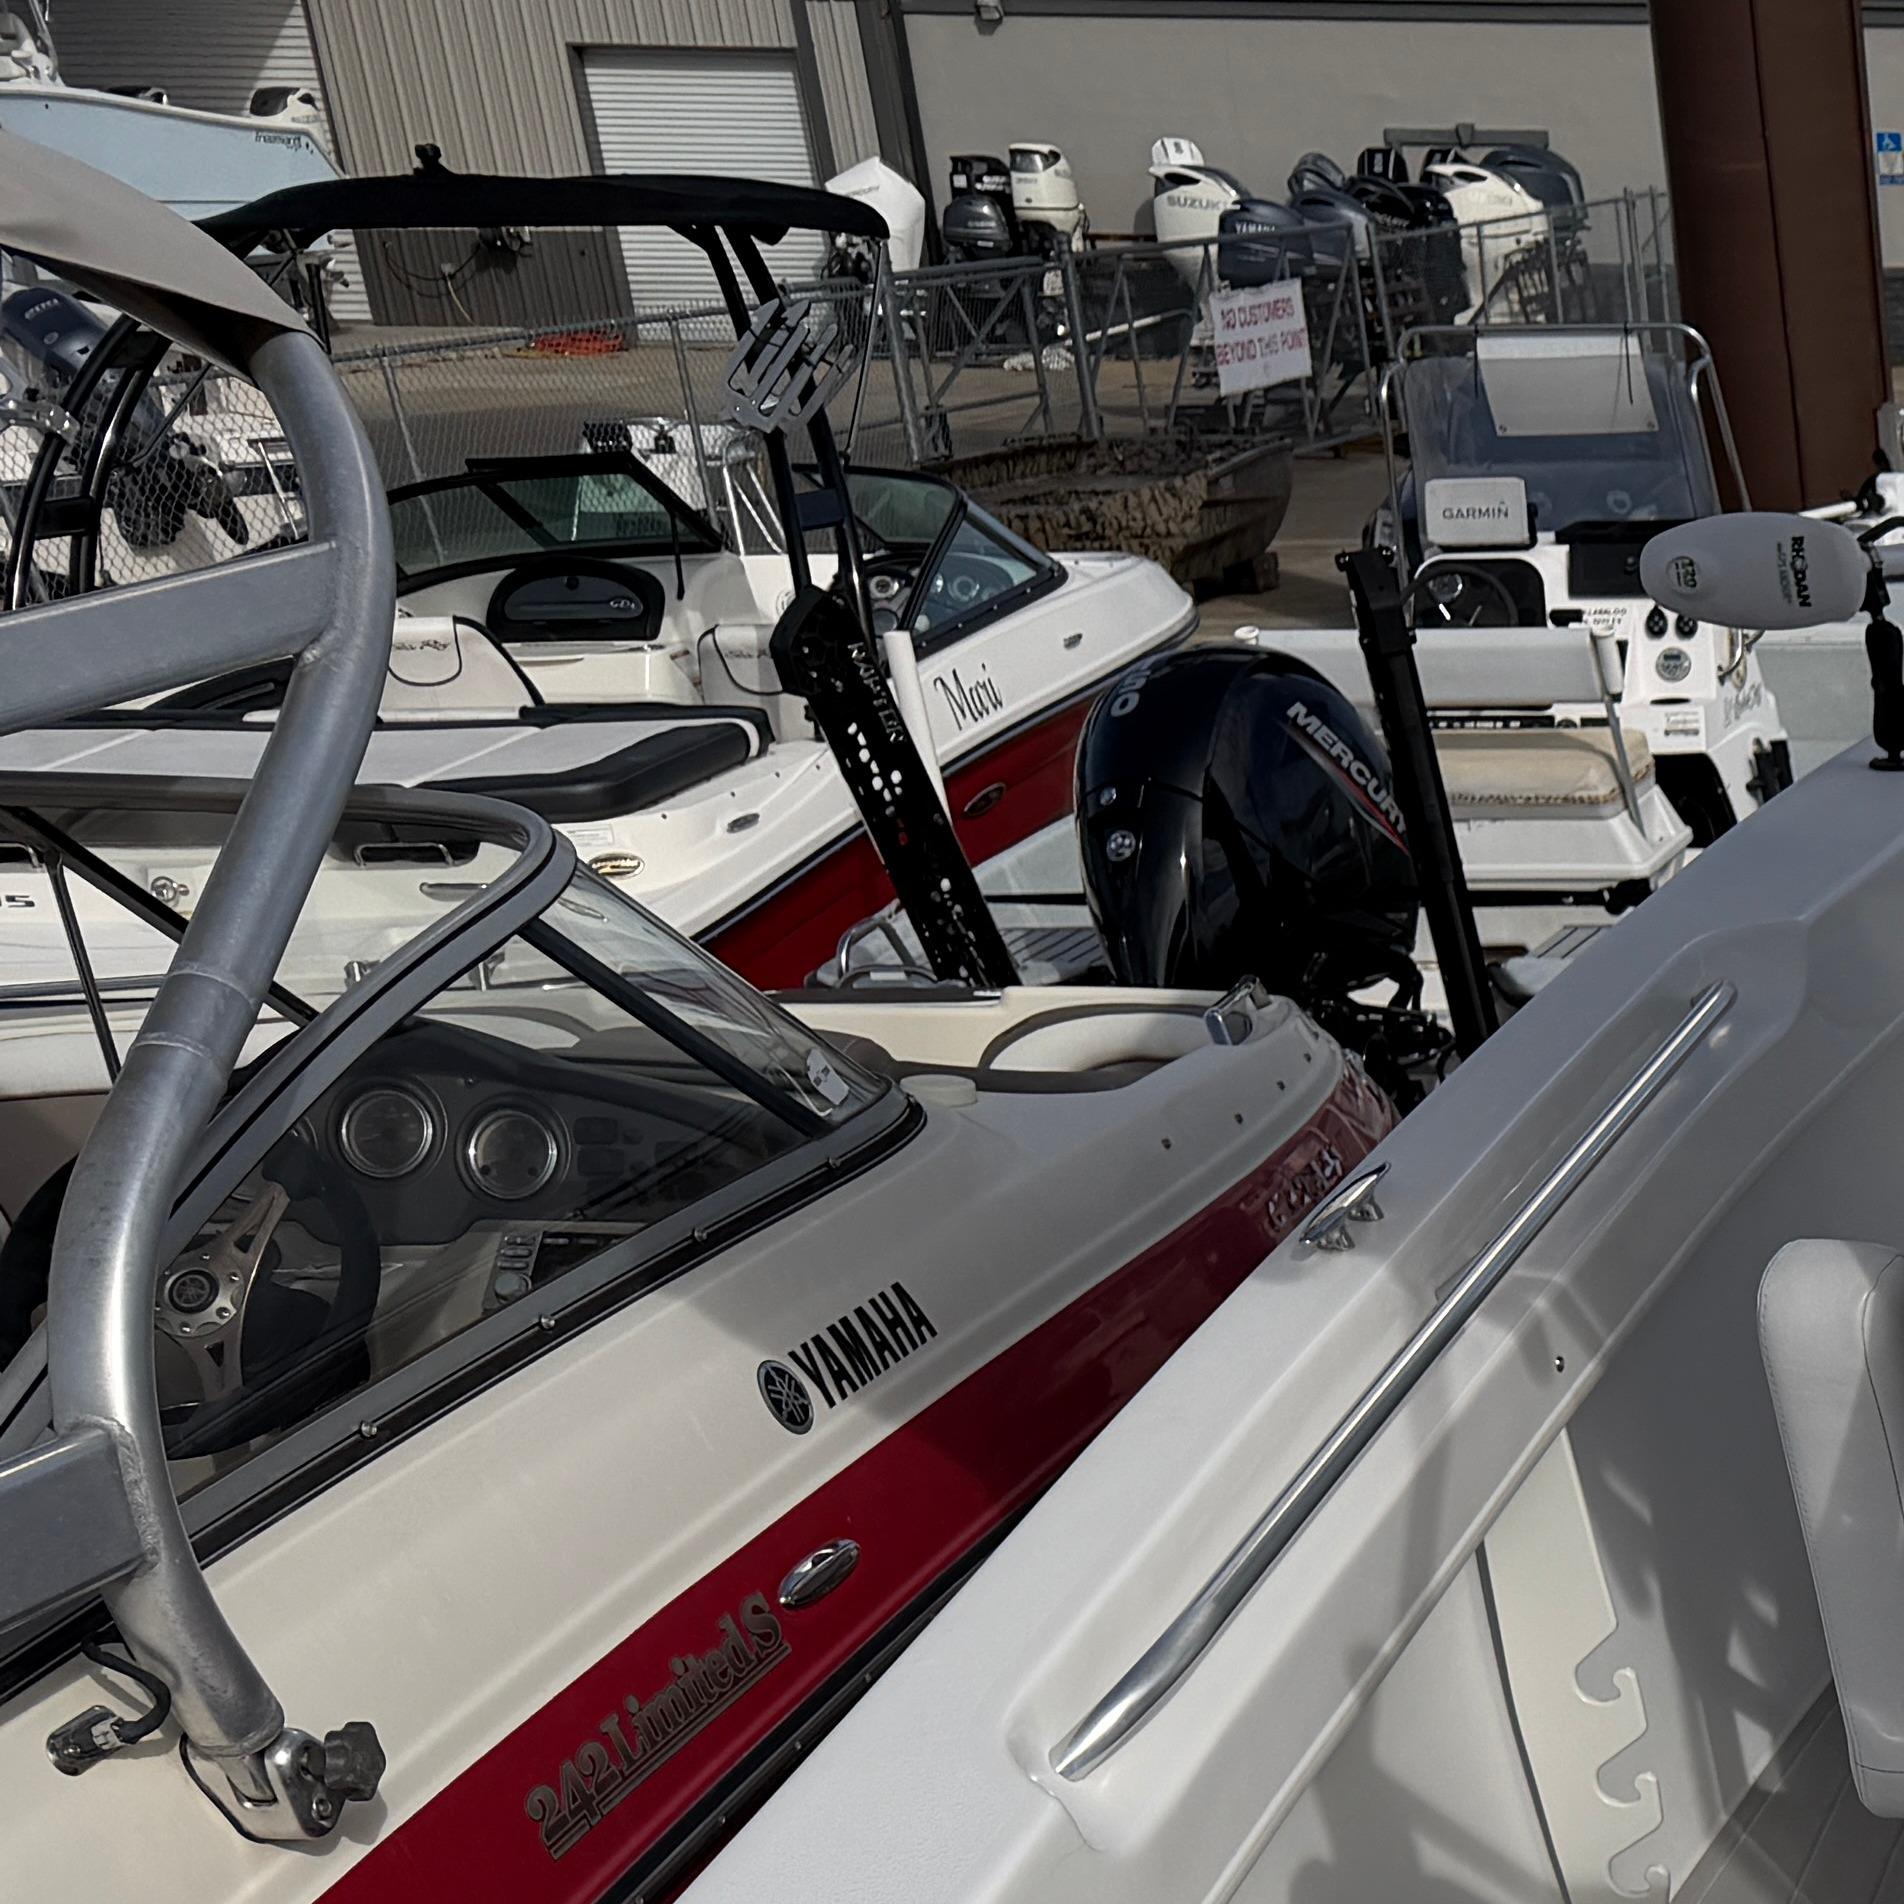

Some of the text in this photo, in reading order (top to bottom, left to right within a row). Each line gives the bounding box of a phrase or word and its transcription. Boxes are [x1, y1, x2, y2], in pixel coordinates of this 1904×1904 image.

[1441, 506, 1510, 521] GARMIN
[933, 662, 1004, 732] Mari
[787, 1281, 938, 1409] YAMAHA
[525, 1741, 624, 1850] 242
